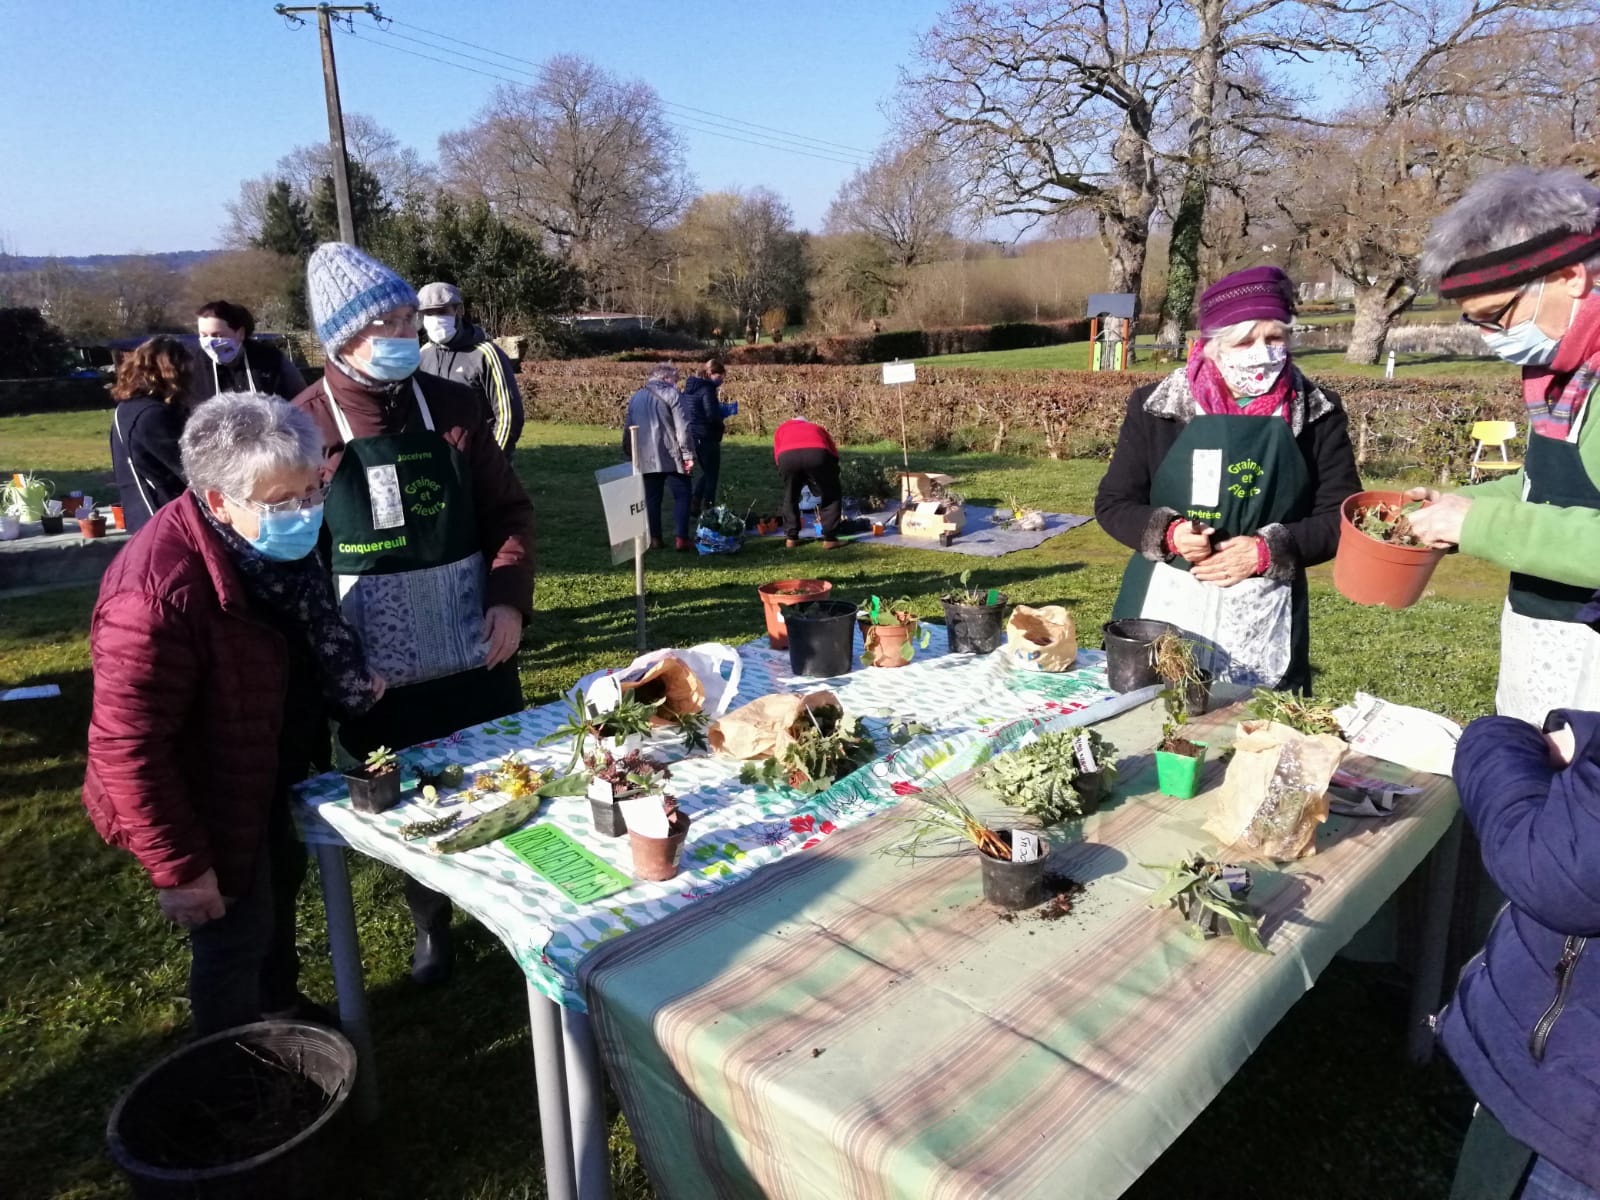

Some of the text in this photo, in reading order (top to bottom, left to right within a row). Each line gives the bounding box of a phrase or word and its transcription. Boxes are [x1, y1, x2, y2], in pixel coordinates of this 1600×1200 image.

[1228, 458, 1264, 476] Graines
[404, 476, 441, 494] Graines
[1241, 474, 1253, 483] et
[420, 490, 432, 502] et
[410, 502, 446, 517] Fleurs
[339, 536, 407, 554] Conquereuil
